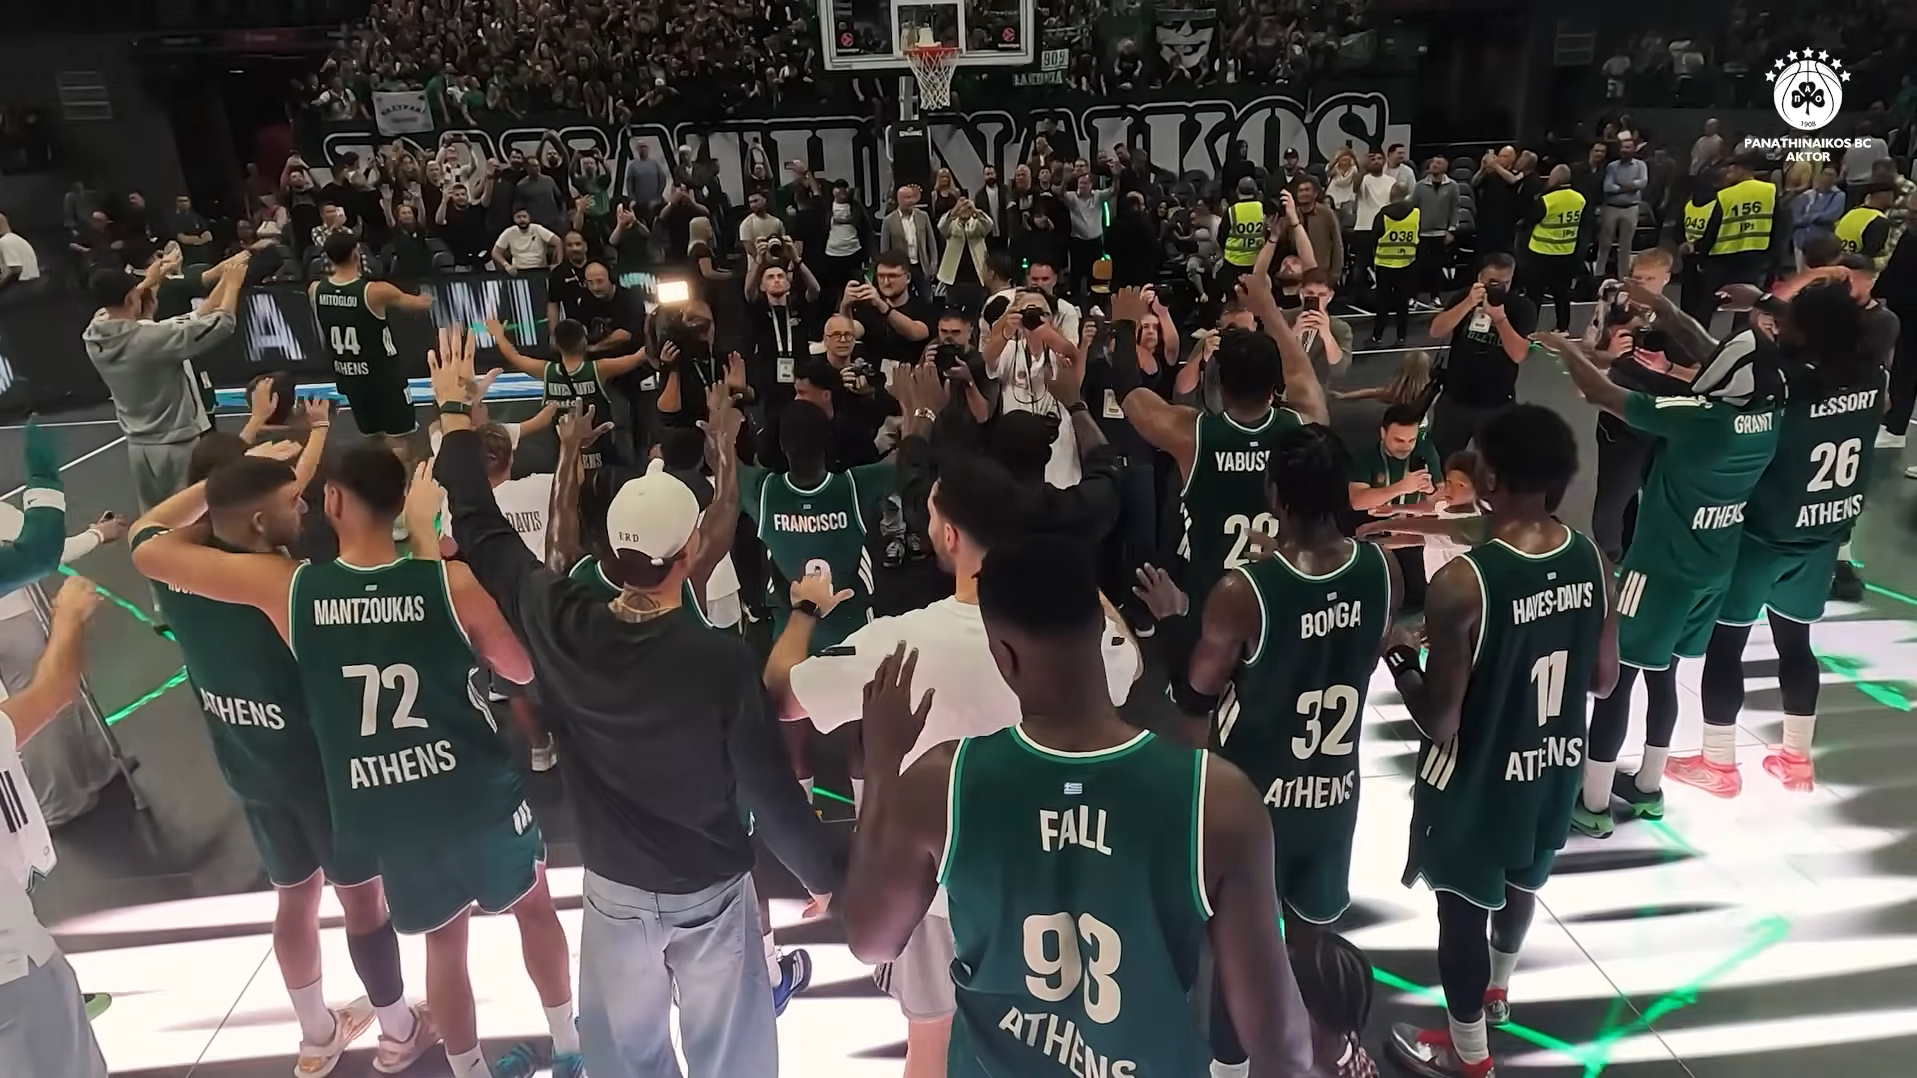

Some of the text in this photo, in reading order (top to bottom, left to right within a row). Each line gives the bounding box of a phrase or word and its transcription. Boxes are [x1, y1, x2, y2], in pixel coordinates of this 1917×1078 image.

[1558, 211, 1580, 223] 155
[1685, 217, 1706, 230] 043
[1731, 202, 1762, 216] 156
[1236, 222, 1263, 234] 002
[1390, 231, 1413, 242] 038
[318, 294, 358, 307] MITOGLOU
[330, 326, 361, 355] 44
[333, 360, 370, 376] AHENS
[1809, 389, 1879, 419] LESSORT
[1733, 411, 1774, 434] GRANT
[1215, 450, 1270, 472] YABUS
[1806, 437, 1862, 492] 26
[773, 511, 848, 533] FRANCISCO
[1691, 501, 1747, 530] ATHENS
[1795, 493, 1863, 528] ATHENS
[314, 595, 425, 626] MANTZOUKAS
[341, 663, 429, 737] 72
[1530, 650, 1569, 727] 11
[200, 687, 286, 730] ATHENS
[1291, 684, 1359, 760] 32
[350, 740, 457, 790] ATHENS
[1504, 736, 1583, 782] ATNS
[1263, 769, 1356, 809] ATHENS
[1039, 804, 1113, 856] FALL
[1023, 911, 1122, 1024] 93
